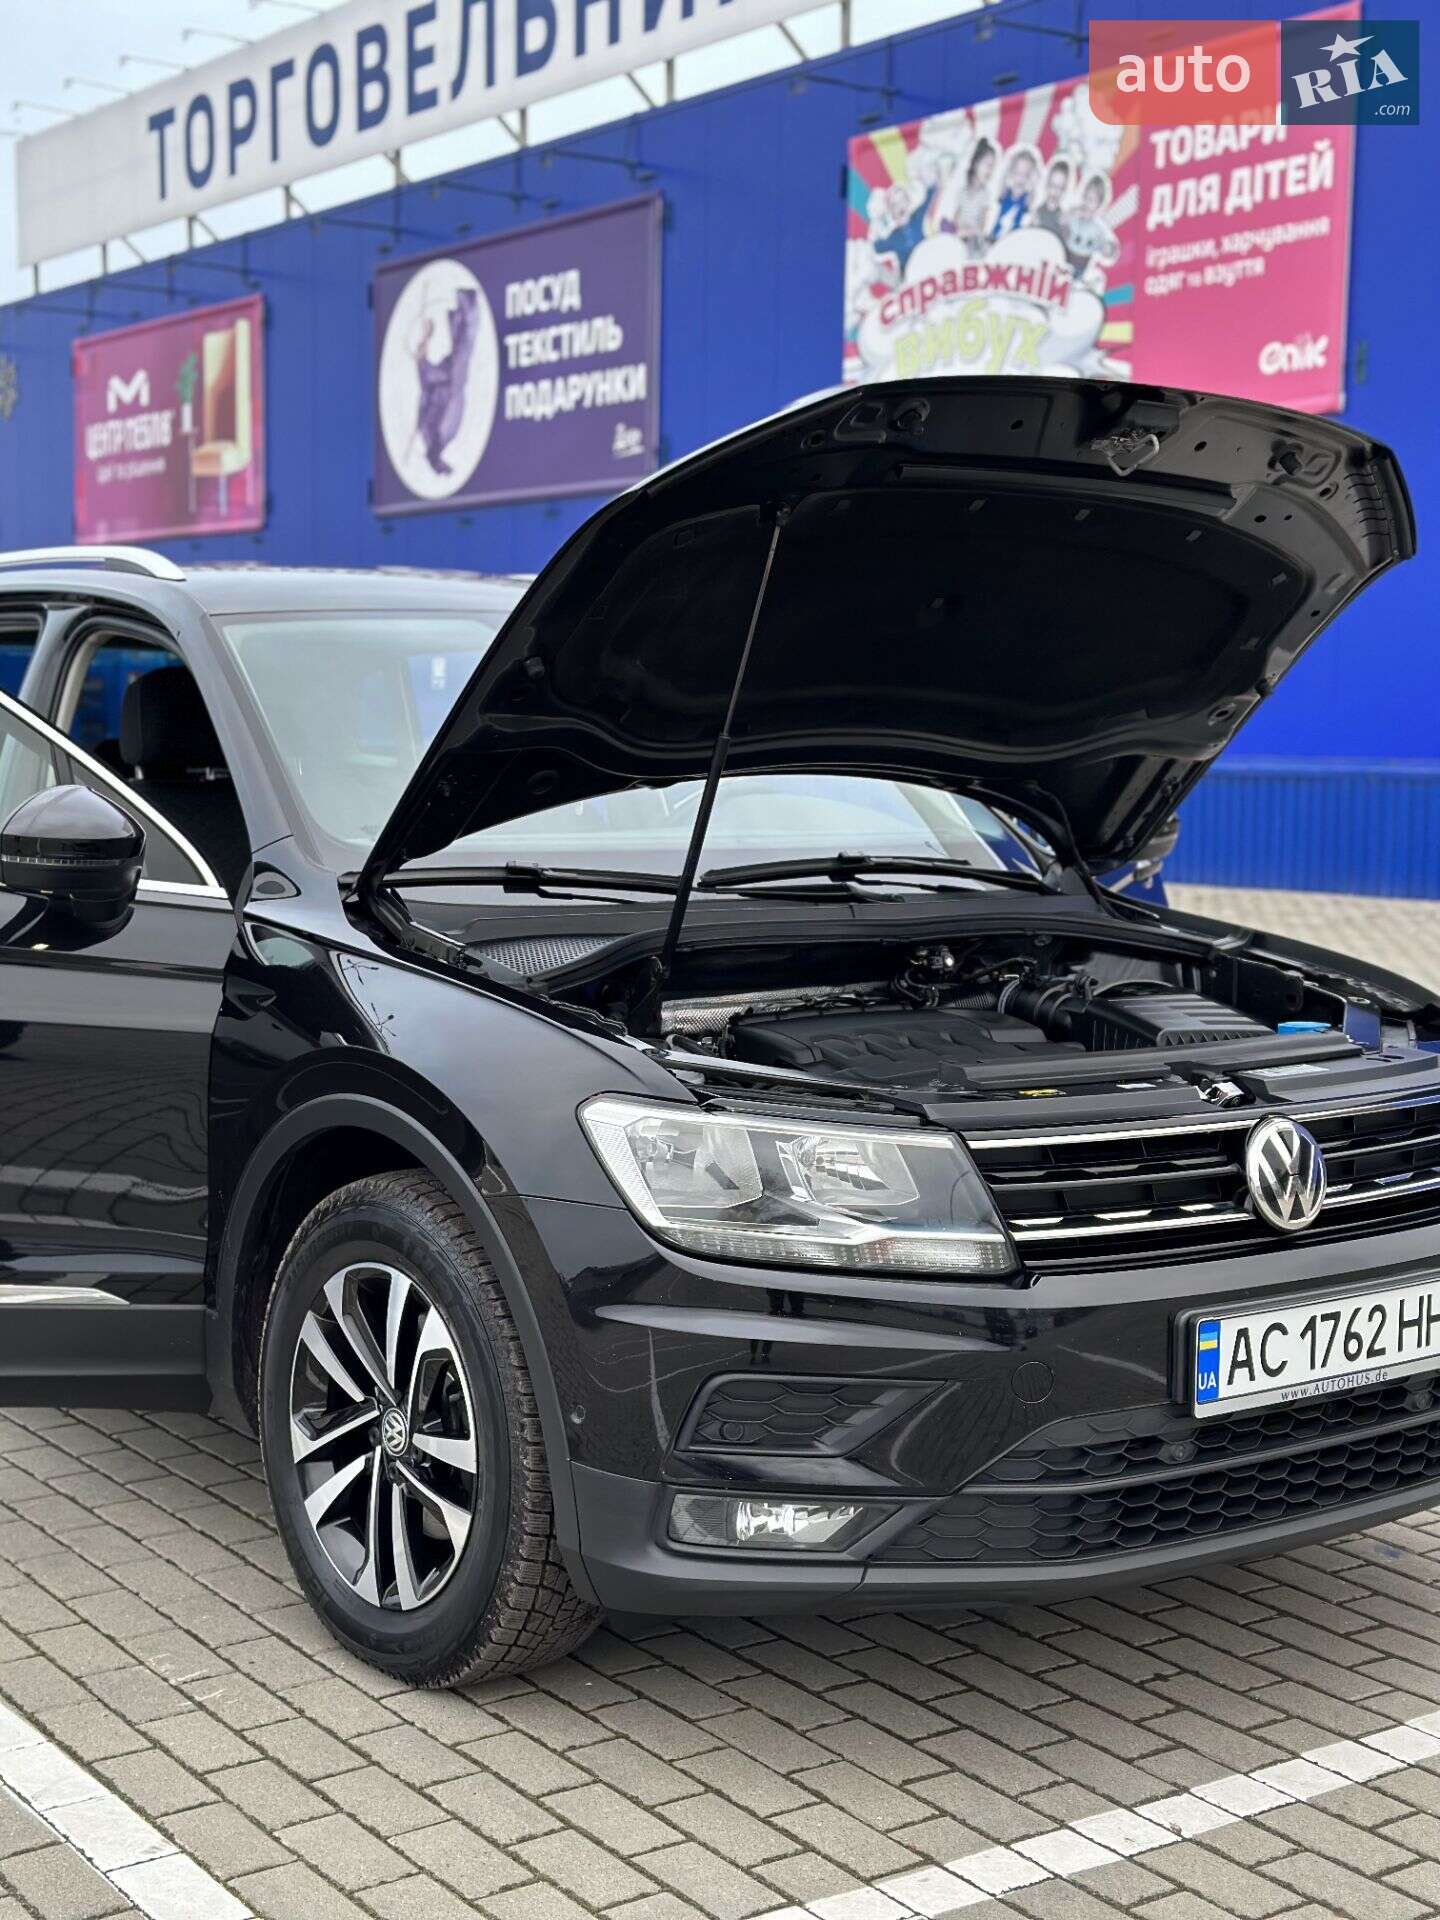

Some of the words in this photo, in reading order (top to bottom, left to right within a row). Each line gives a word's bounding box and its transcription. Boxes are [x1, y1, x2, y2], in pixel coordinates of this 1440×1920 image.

[1146, 172, 1221, 232] ДЛЯ
[1224, 138, 1335, 216] ДІТЕЙ
[505, 268, 581, 319] ПОСУД
[504, 313, 623, 369] ТЕКСТИЛЬ
[504, 362, 647, 421] ПОДАРУНКИ
[1227, 1322, 1289, 1385] AC
[1300, 1304, 1387, 1370] 1762
[1198, 1373, 1217, 1390] UA
[1281, 1370, 1388, 1401] www.AUTOHUS.de
